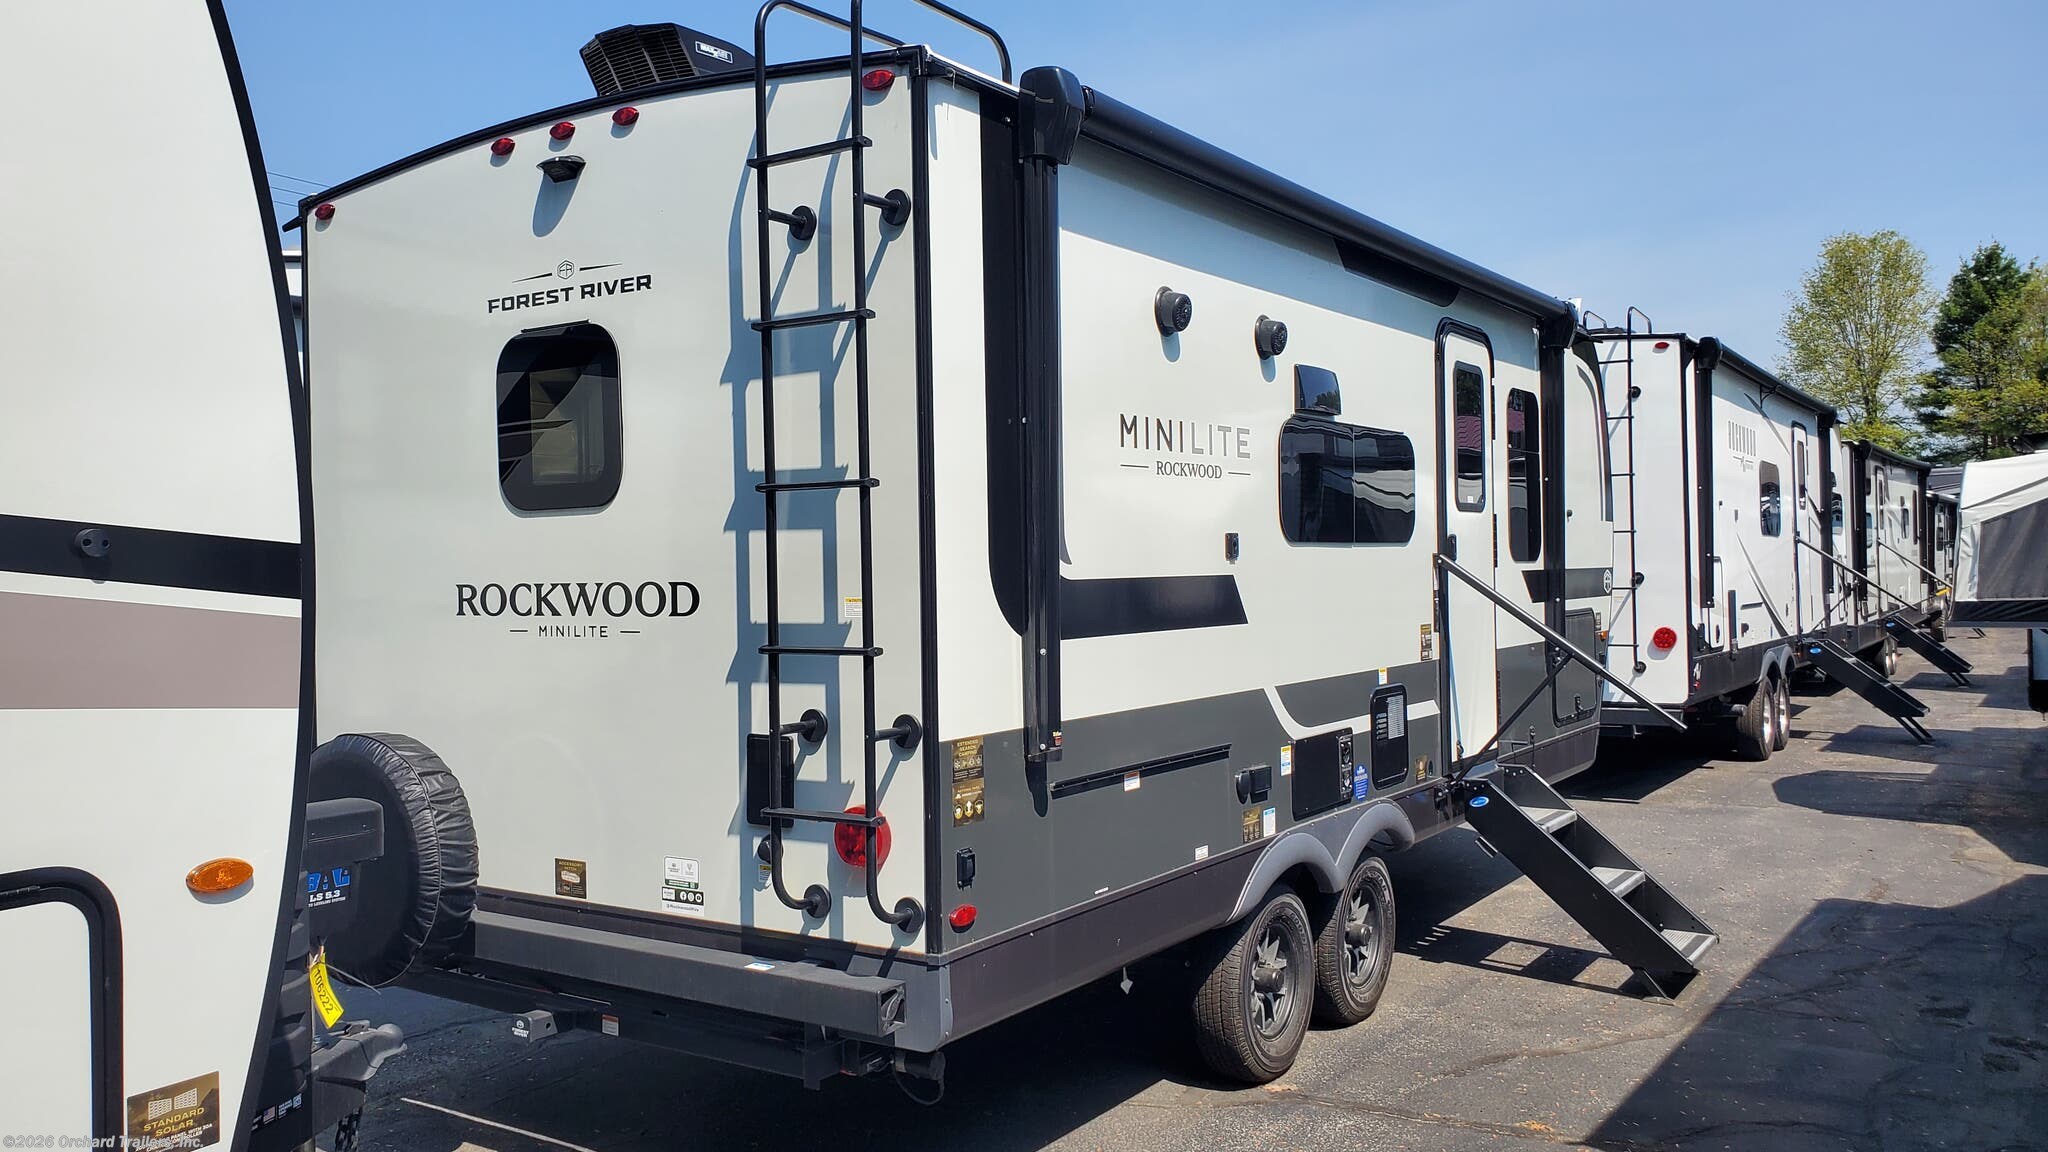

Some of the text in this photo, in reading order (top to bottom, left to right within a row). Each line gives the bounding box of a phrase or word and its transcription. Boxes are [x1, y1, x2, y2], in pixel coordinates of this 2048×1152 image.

[487, 274, 652, 313] FOREST RIVER
[1119, 413, 1251, 459] MINILITE
[1156, 460, 1223, 479] ROCKWOOD
[455, 581, 701, 618] ROCKWOOD
[538, 625, 609, 638] MINILITE
[309, 892, 324, 903] LS
[143, 1107, 205, 1132] STANDARD
[155, 1119, 194, 1137] SOLAR
